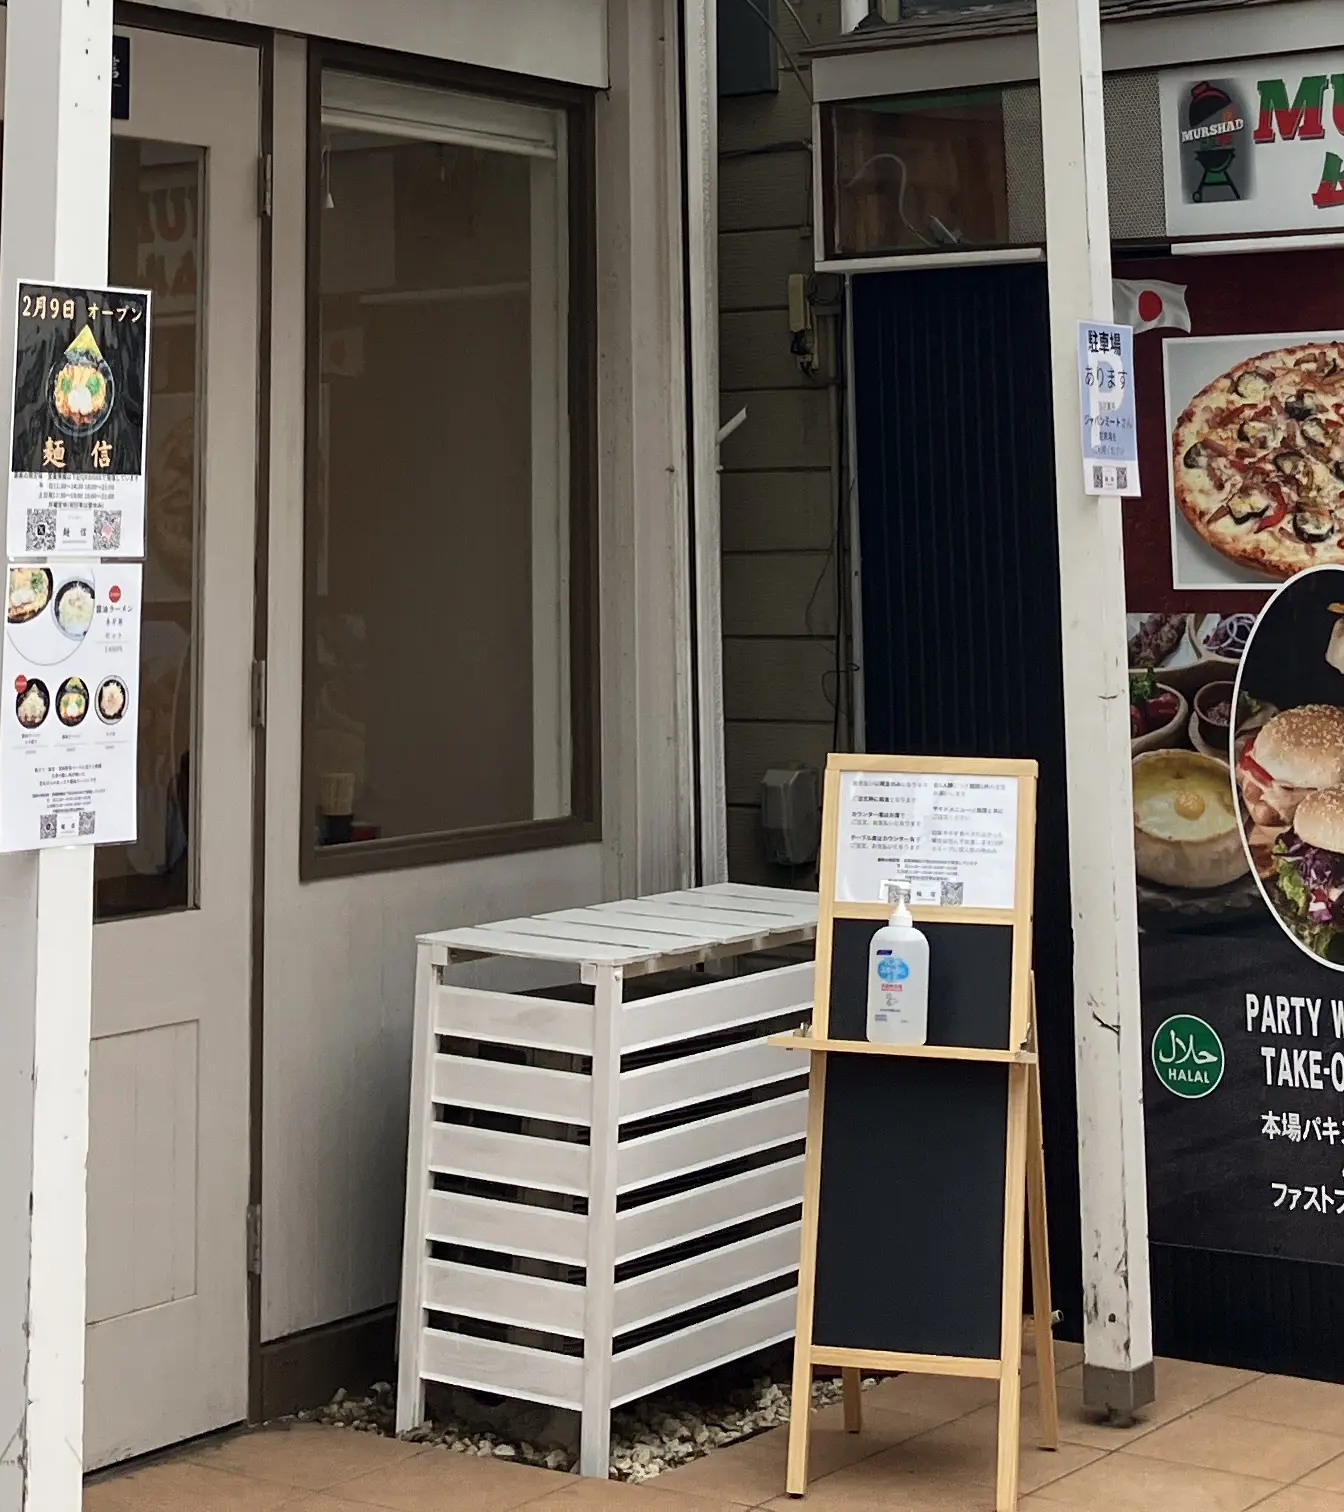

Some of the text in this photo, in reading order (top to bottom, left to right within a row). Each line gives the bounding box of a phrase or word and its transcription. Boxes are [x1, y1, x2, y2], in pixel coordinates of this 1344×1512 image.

[1181, 118, 1244, 143] MURSHAD
[22, 295, 144, 324] 2月9日 オープン
[1087, 330, 1121, 357] 駐車場
[1085, 365, 1128, 390] あります
[92, 439, 113, 469] 信
[96, 604, 133, 614] 醤油ラーメン
[1245, 994, 1322, 1038] PARTY
[1159, 1031, 1219, 1065] حلال
[1167, 1067, 1211, 1085] HALAL
